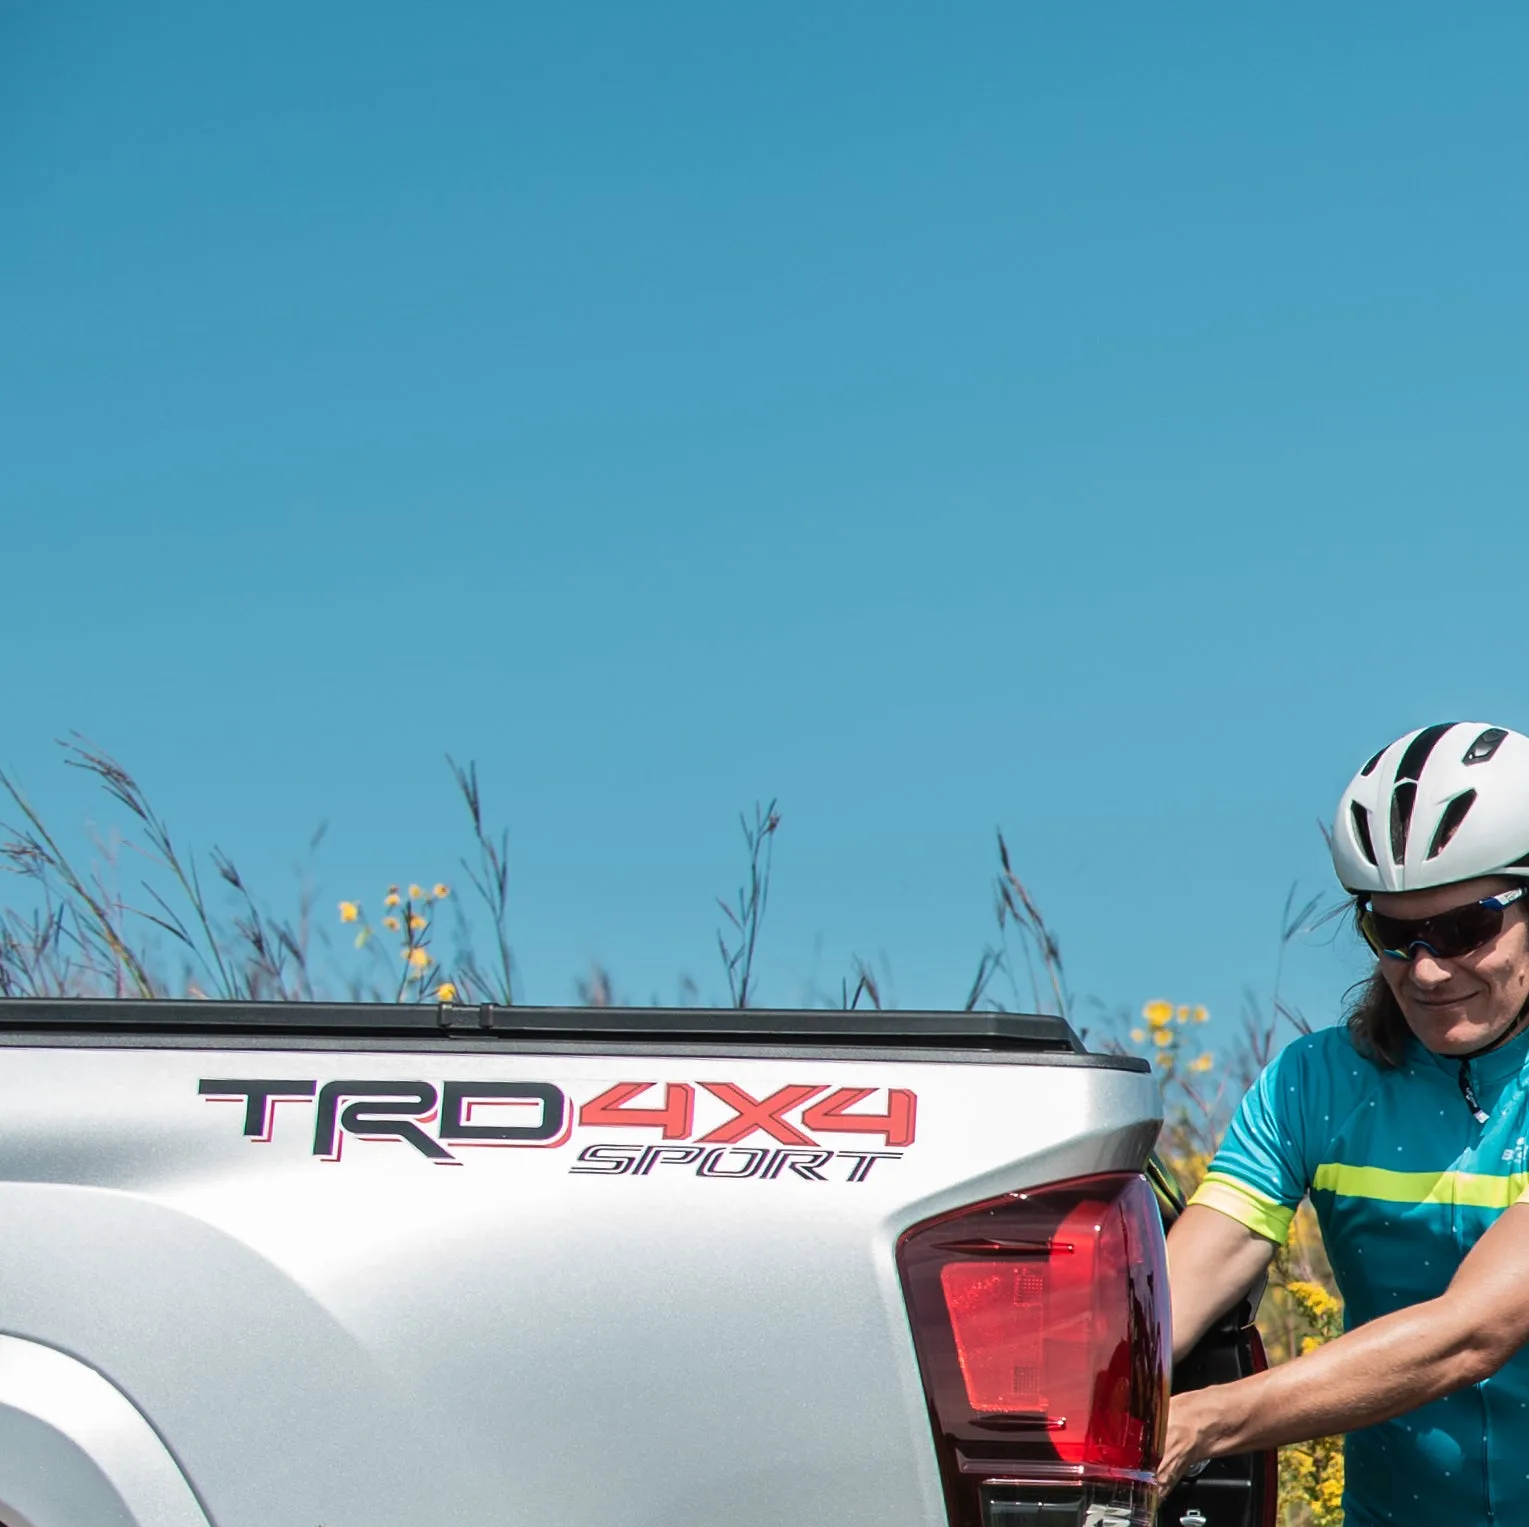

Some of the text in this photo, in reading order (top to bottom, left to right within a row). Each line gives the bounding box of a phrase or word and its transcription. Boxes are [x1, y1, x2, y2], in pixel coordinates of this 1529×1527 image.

[198, 1080, 918, 1166] TRD 4X4
[568, 1144, 904, 1192] SPORT
